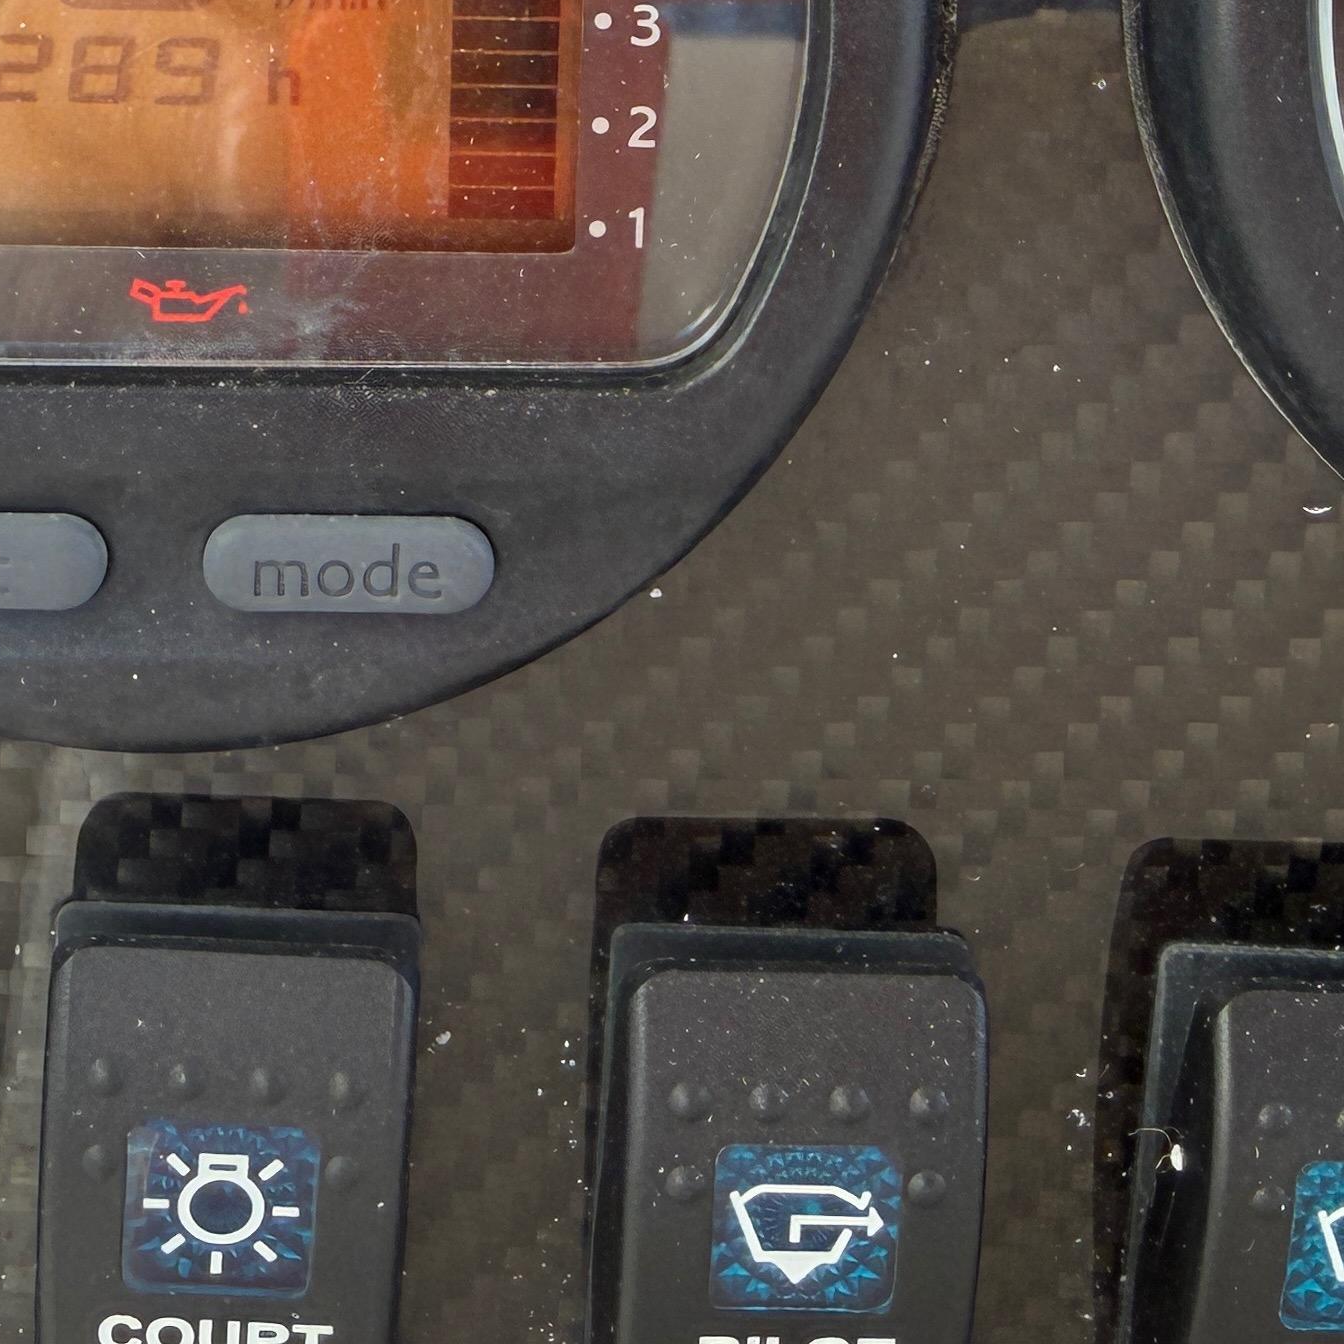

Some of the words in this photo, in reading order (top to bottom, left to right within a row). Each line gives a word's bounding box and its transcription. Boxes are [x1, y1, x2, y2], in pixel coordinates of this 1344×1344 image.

[629, 3, 661, 47] 3
[267, 54, 302, 105] h
[627, 105, 656, 149] 2
[627, 206, 647, 248] 1
[253, 543, 445, 599] mode
